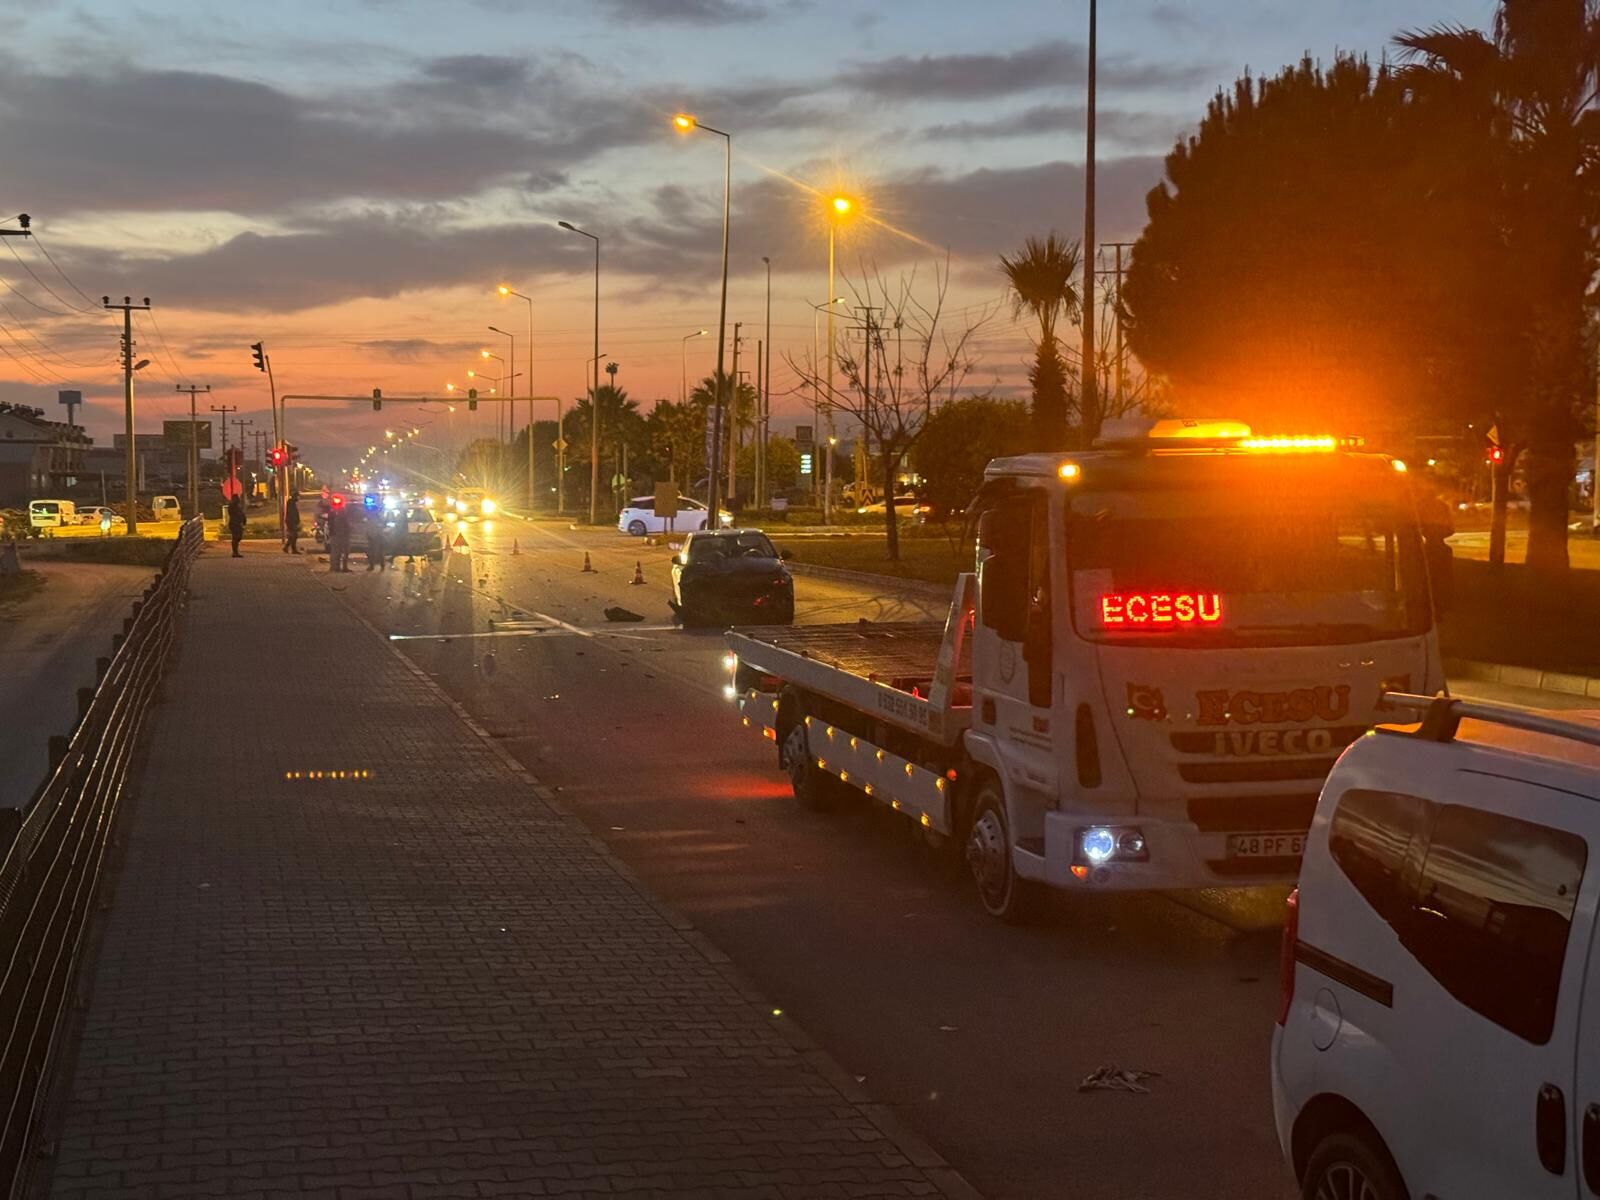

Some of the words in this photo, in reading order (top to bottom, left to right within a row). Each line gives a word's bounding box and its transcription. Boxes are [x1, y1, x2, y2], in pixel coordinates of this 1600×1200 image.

[1102, 594, 1221, 622] ECESU
[1196, 685, 1351, 725] ECESU
[1216, 730, 1332, 756] IVECO
[1237, 838, 1259, 854] 48
[1264, 838, 1286, 853] PF
